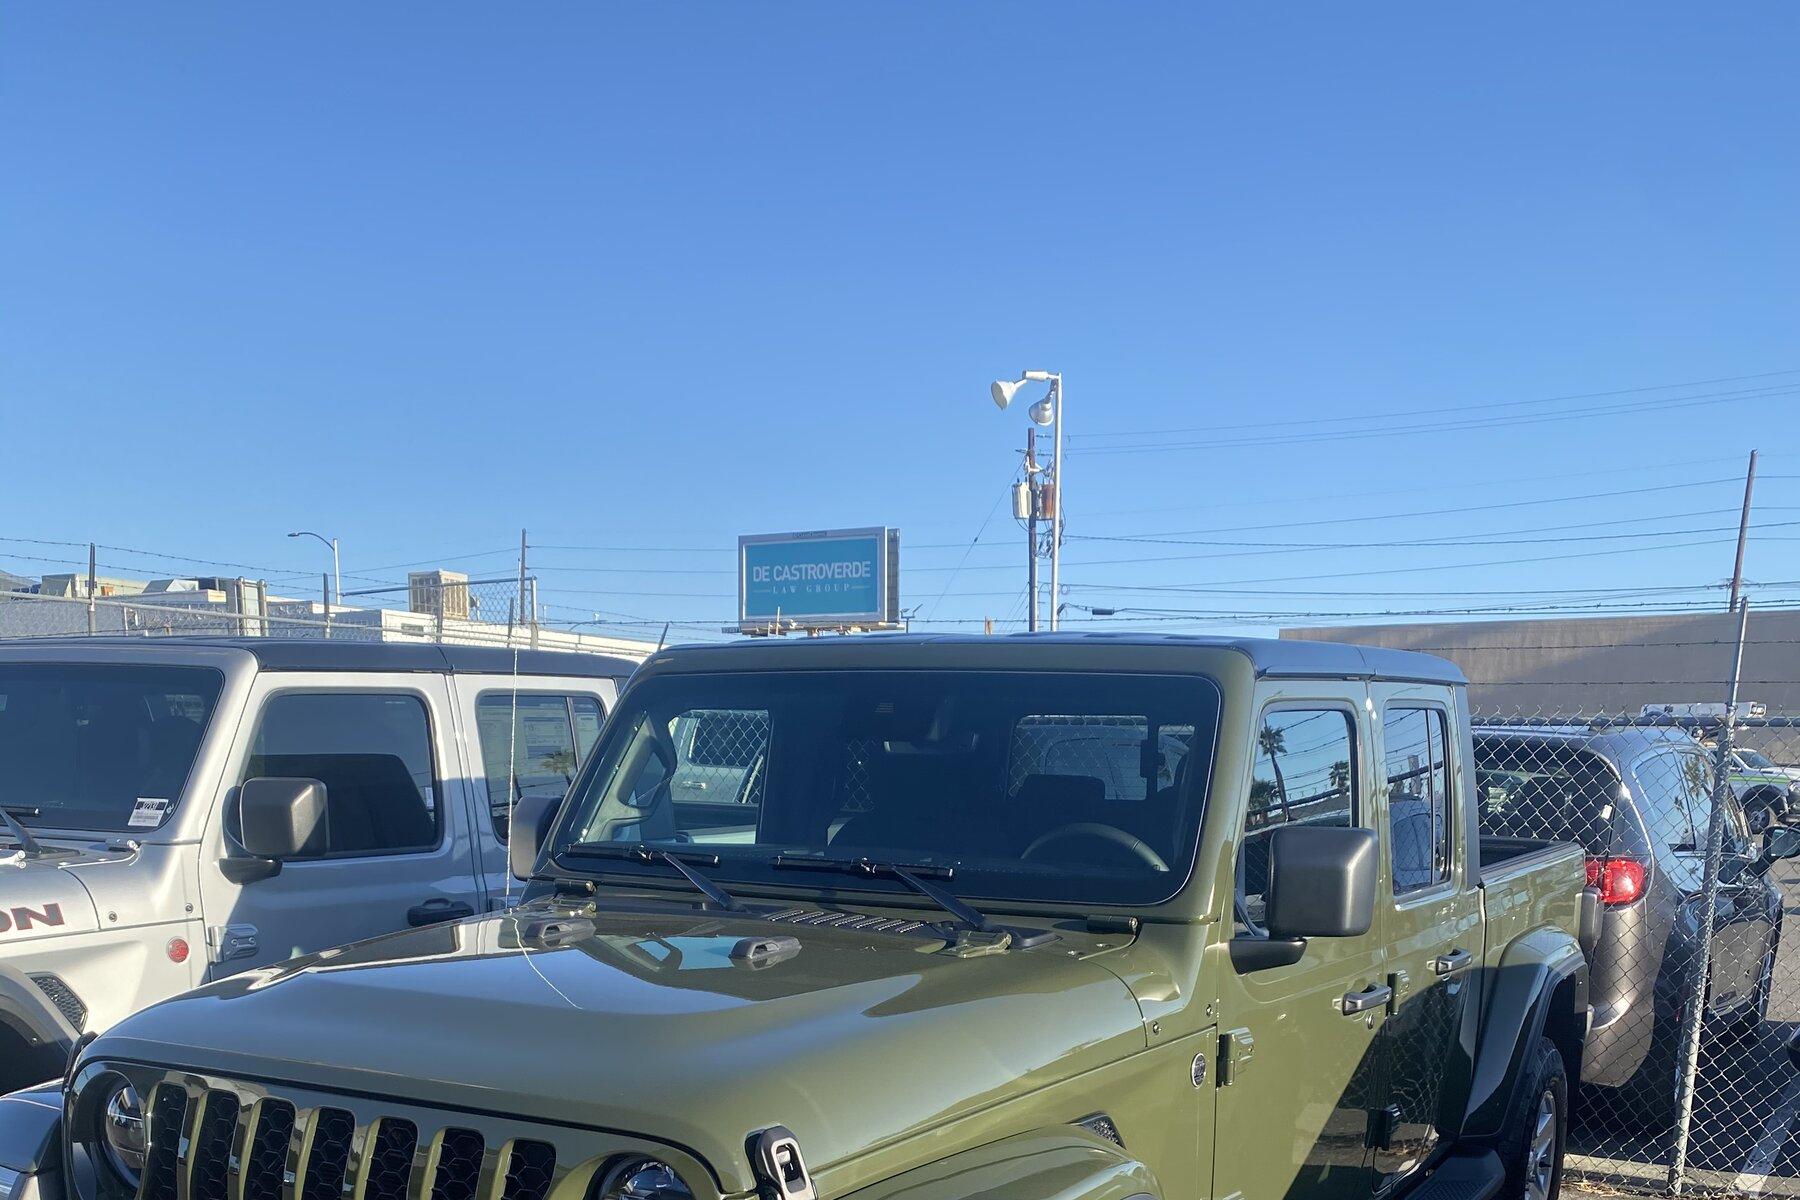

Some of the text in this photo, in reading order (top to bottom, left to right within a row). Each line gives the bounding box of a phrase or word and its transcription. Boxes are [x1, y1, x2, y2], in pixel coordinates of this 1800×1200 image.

[753, 561, 871, 582] DE CASTROVERDE
[773, 583, 850, 594] LAW GROUP
[0, 903, 65, 932] N
